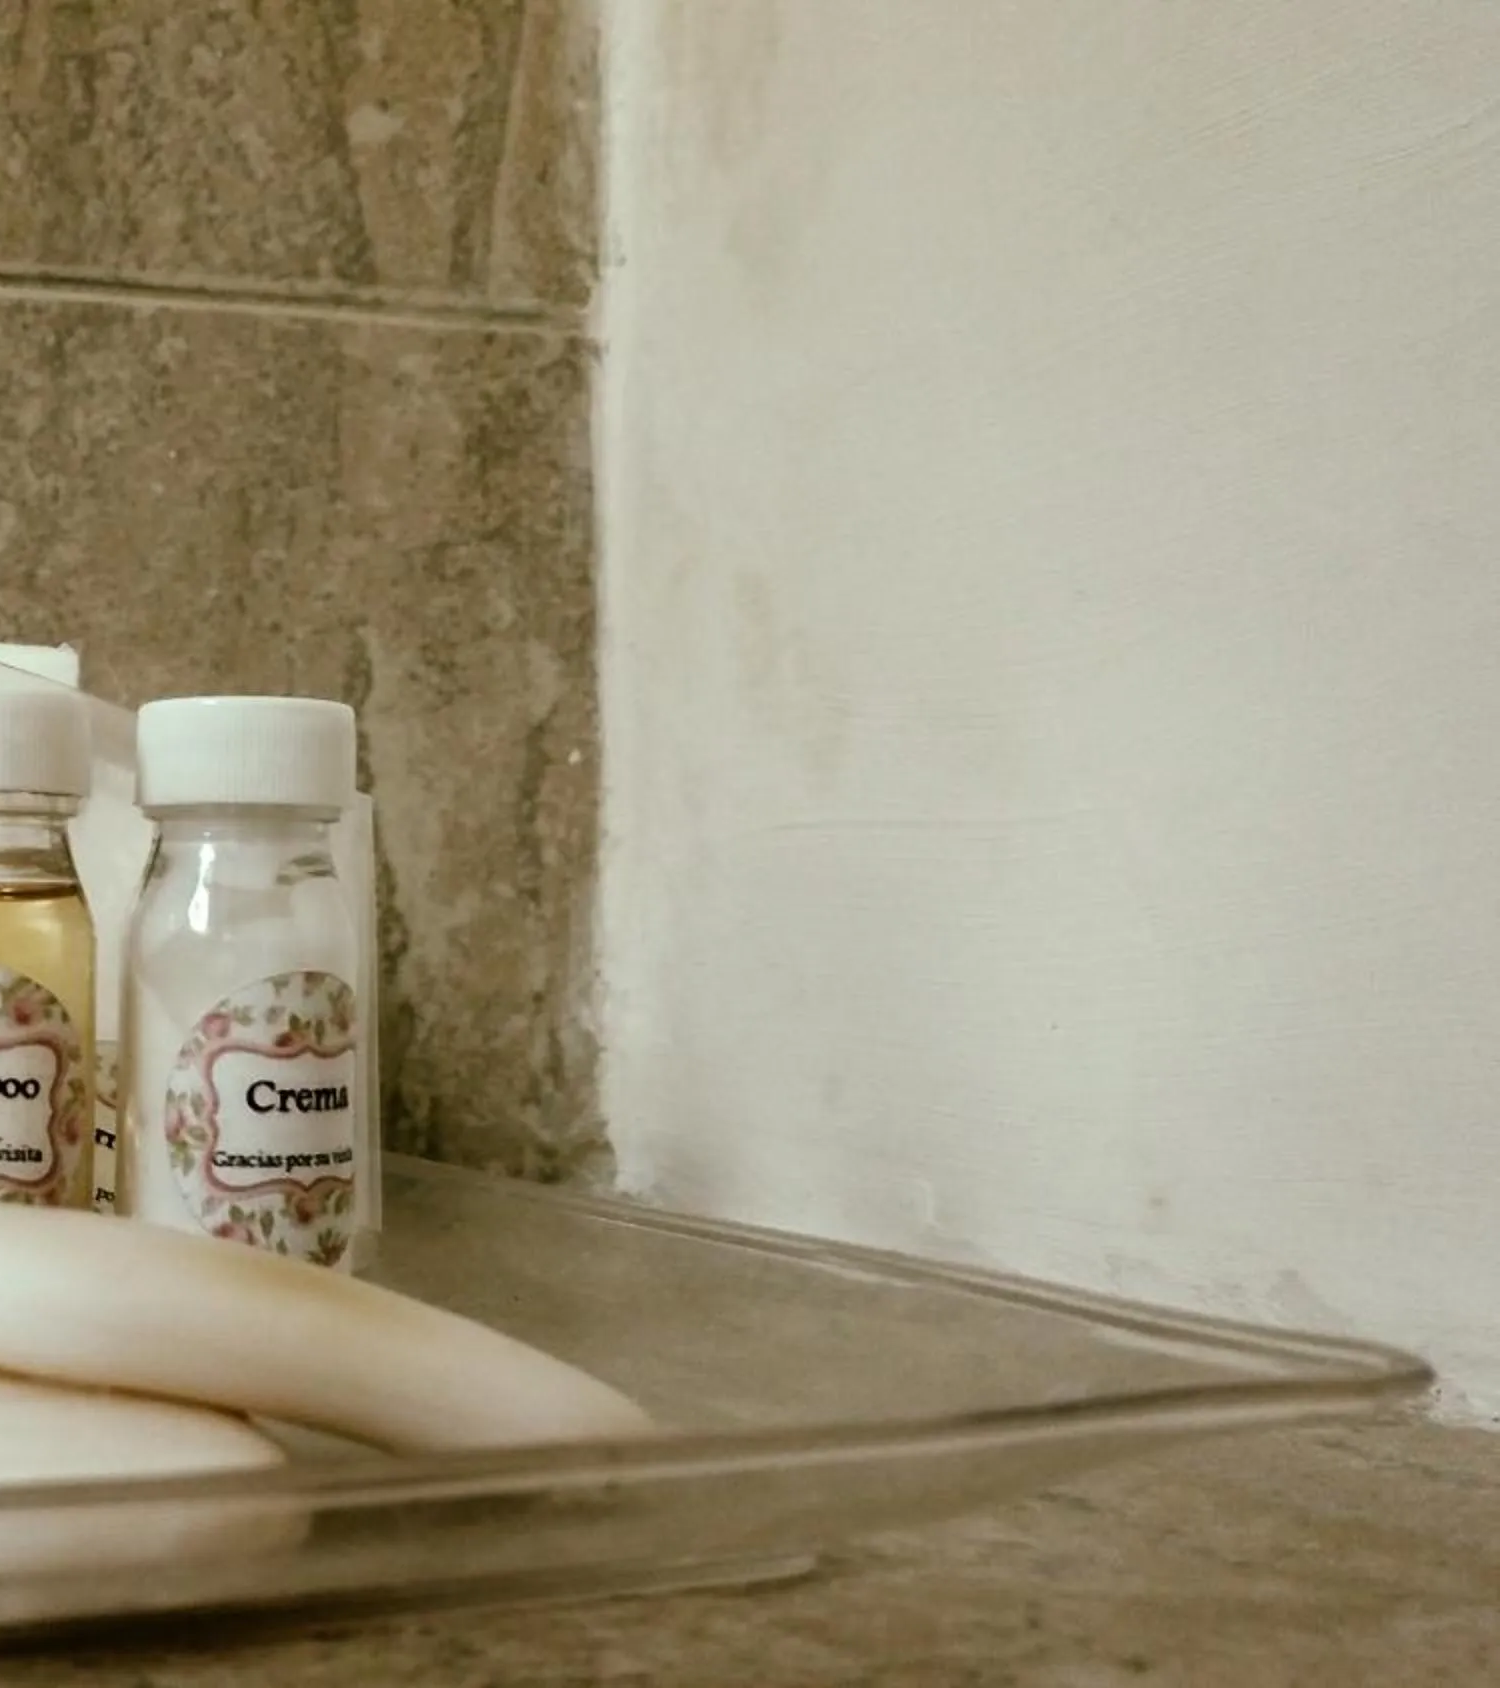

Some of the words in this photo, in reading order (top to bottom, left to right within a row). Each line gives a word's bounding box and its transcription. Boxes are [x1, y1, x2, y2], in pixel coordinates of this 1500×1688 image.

[246, 1079, 349, 1113] Crema
[213, 1150, 282, 1168] Gracias
[285, 1153, 312, 1173] por
